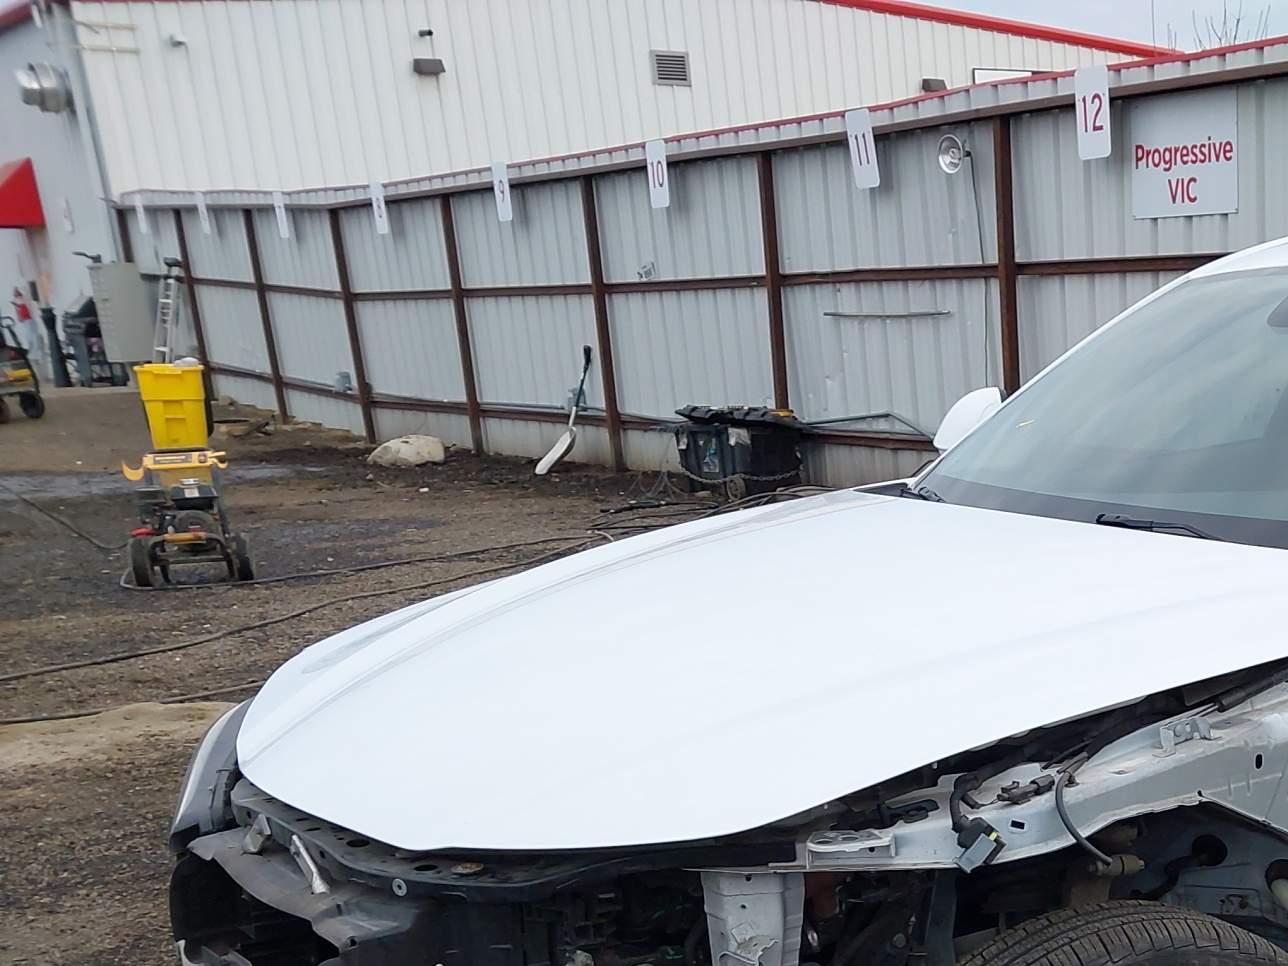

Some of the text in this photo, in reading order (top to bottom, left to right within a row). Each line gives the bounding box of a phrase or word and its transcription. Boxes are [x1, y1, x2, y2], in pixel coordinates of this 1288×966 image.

[1081, 92, 1105, 133] 12
[853, 130, 871, 167] 11
[1134, 136, 1234, 172] Progressive
[650, 159, 665, 189] 10
[1167, 176, 1199, 205] VIC
[498, 179, 506, 203] 9
